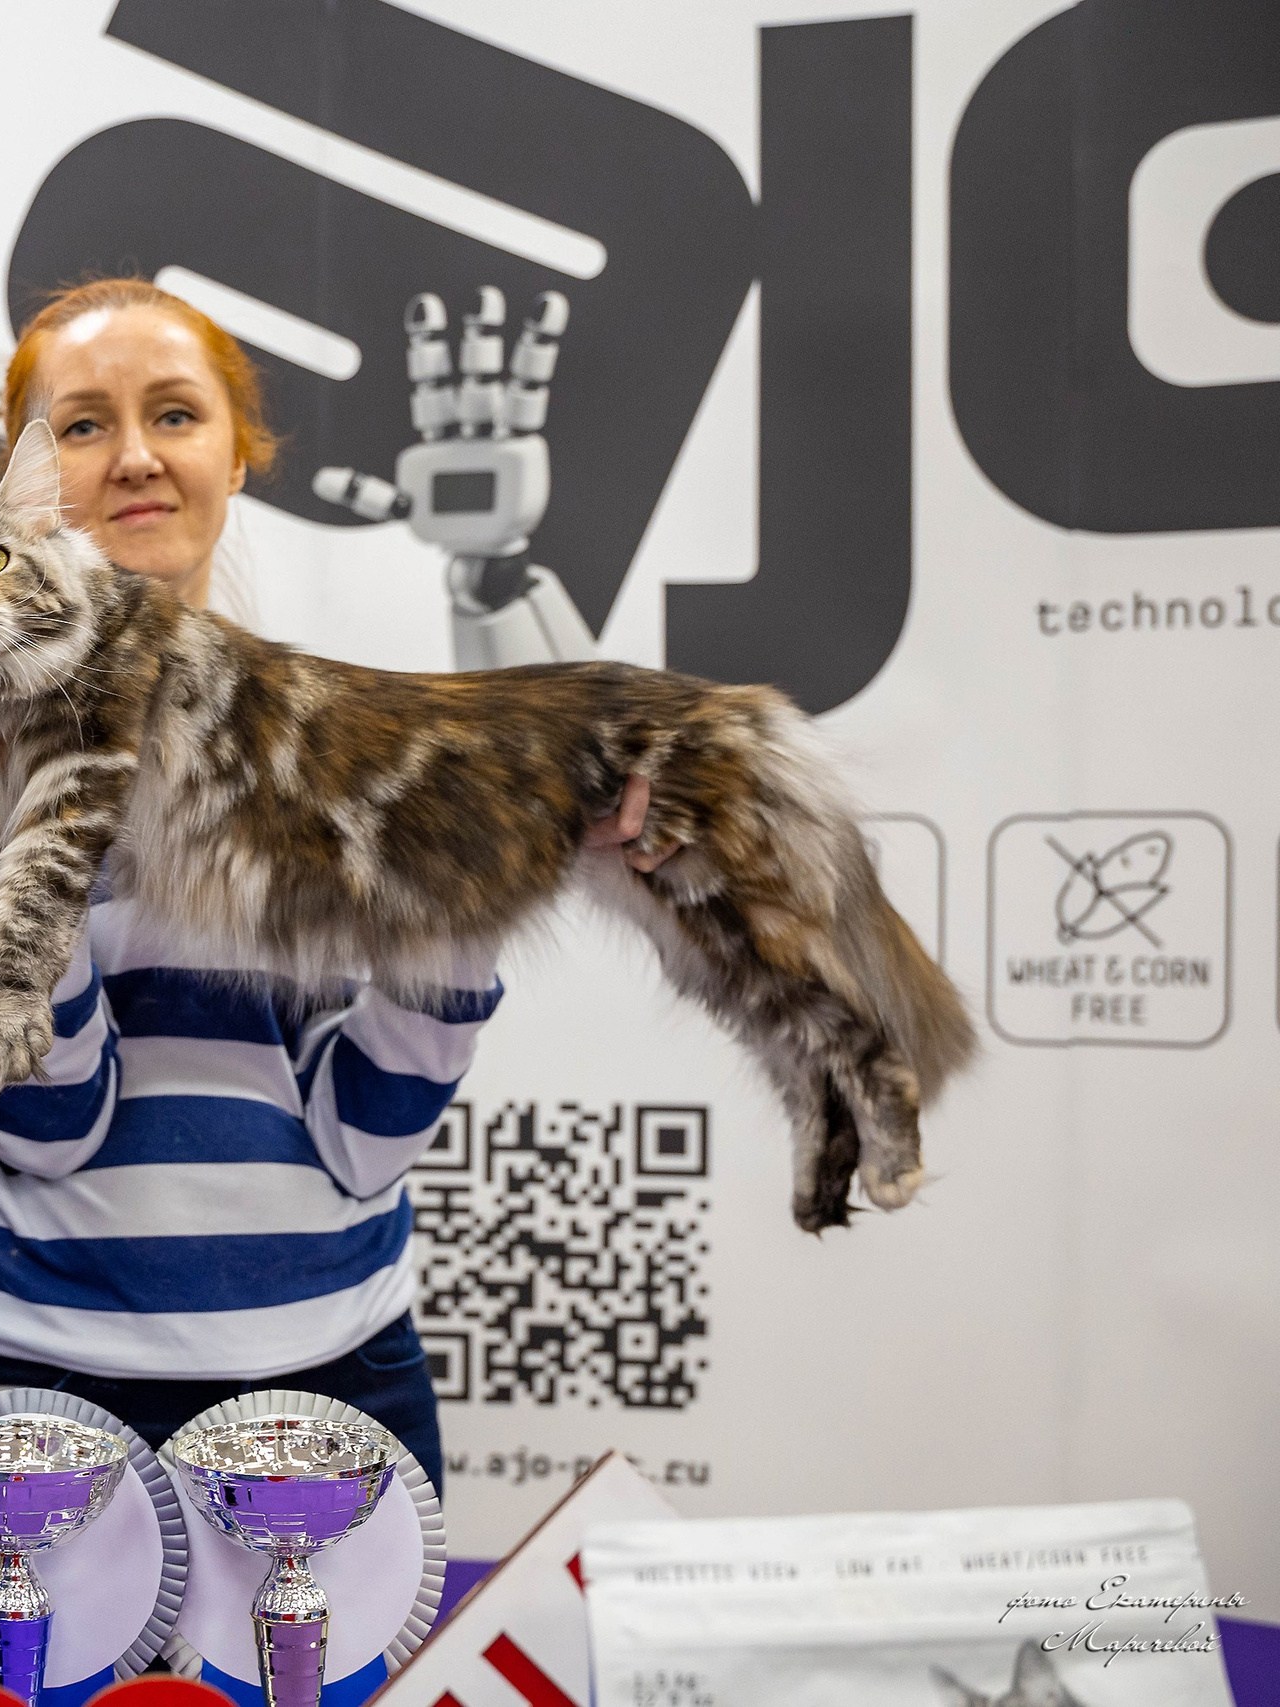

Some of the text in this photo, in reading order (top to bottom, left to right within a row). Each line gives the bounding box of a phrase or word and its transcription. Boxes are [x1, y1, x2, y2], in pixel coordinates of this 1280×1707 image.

[1007, 953, 1213, 988] WHEAT & CORN
[1070, 993, 1148, 1027] FREE
[835, 1557, 872, 1578] LOW
[1100, 1544, 1150, 1565] FREE
